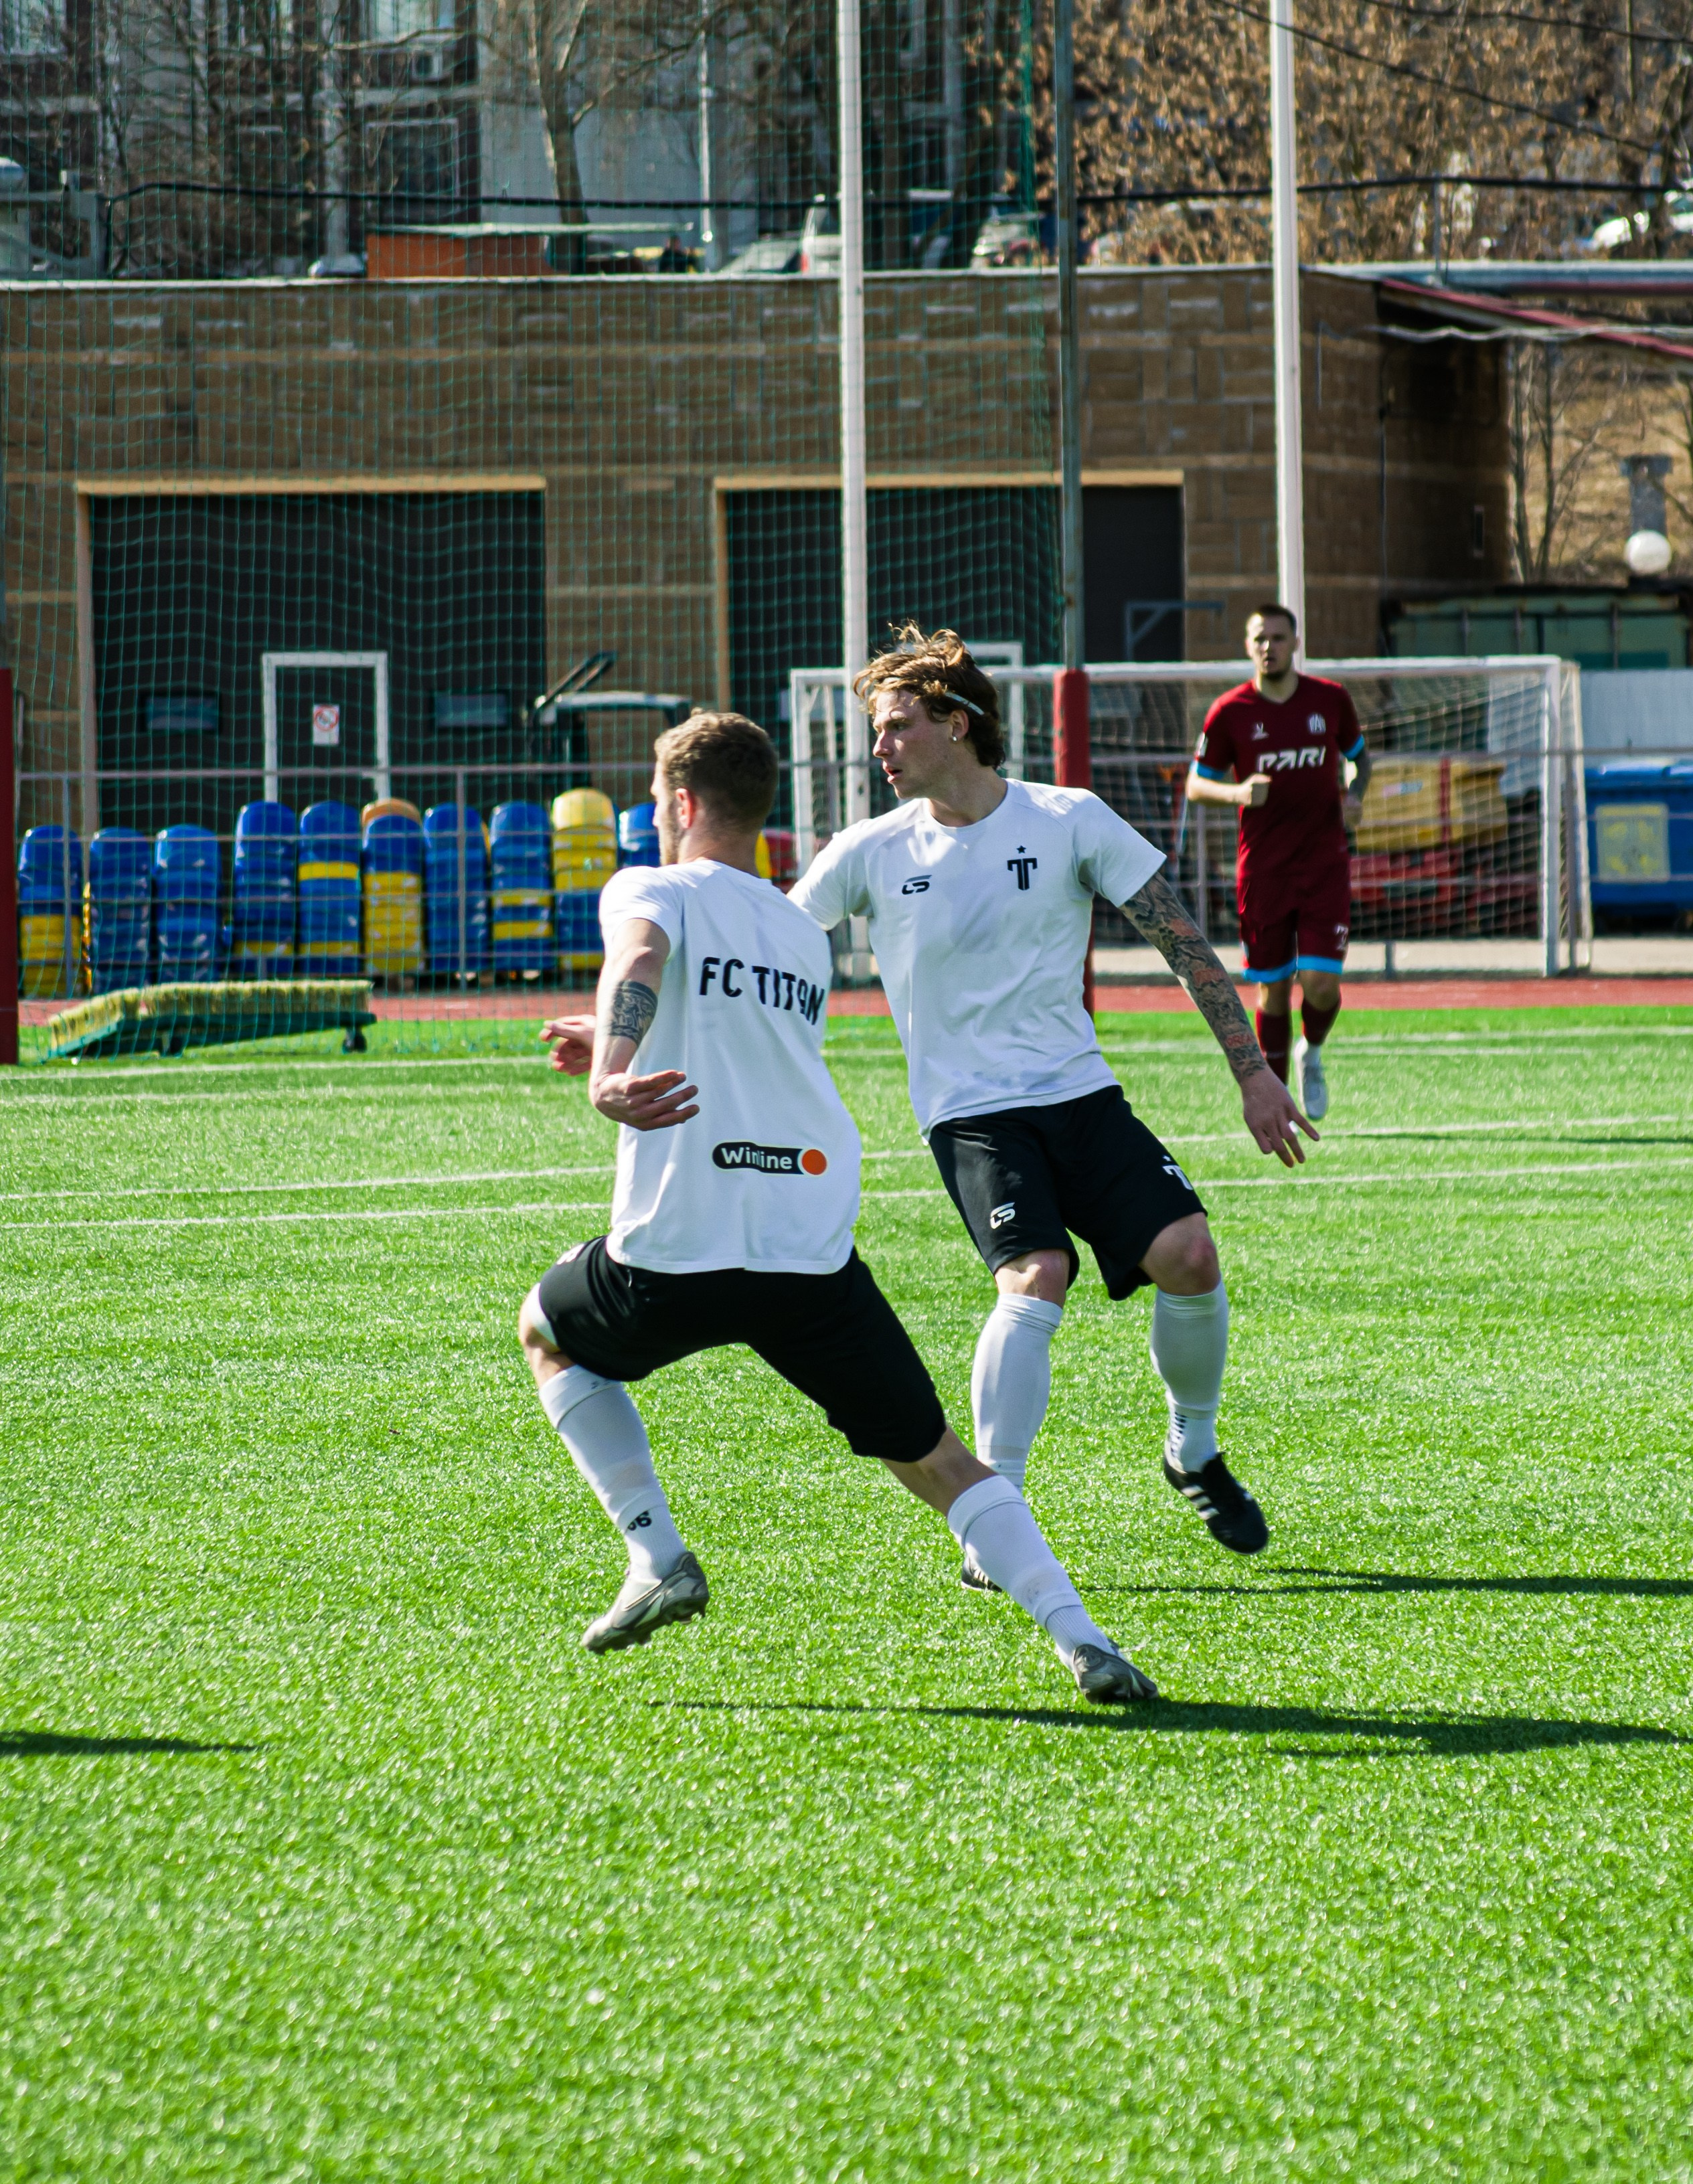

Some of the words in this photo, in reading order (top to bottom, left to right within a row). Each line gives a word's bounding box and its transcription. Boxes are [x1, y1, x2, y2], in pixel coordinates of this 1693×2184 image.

[1257, 746, 1326, 772] PARI
[699, 956, 744, 997] FC
[752, 965, 825, 1025] TITAN
